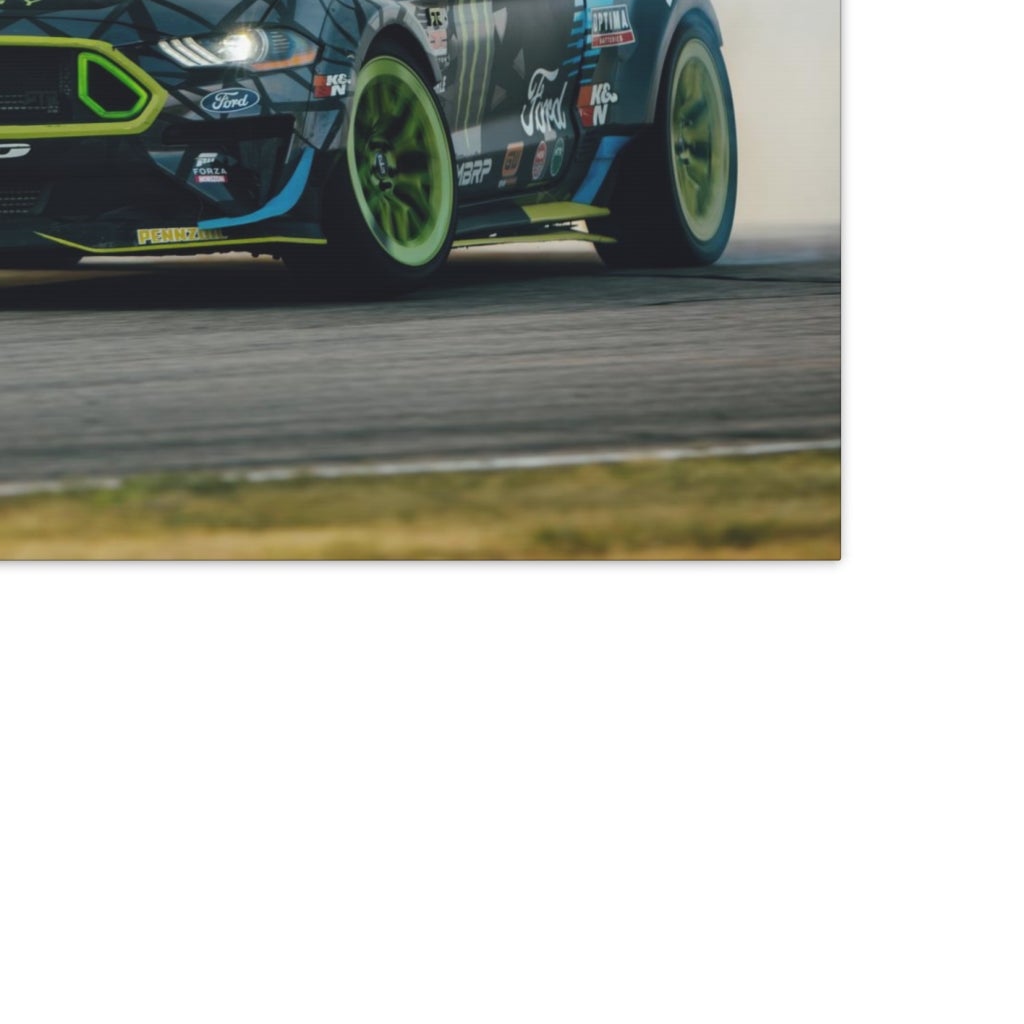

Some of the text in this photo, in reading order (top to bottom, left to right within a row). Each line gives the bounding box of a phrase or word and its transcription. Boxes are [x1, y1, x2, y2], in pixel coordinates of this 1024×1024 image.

[592, 9, 630, 33] OPTIMA
[212, 91, 250, 111] Ford
[520, 67, 569, 137] Ford
[192, 167, 228, 176] FORZA
